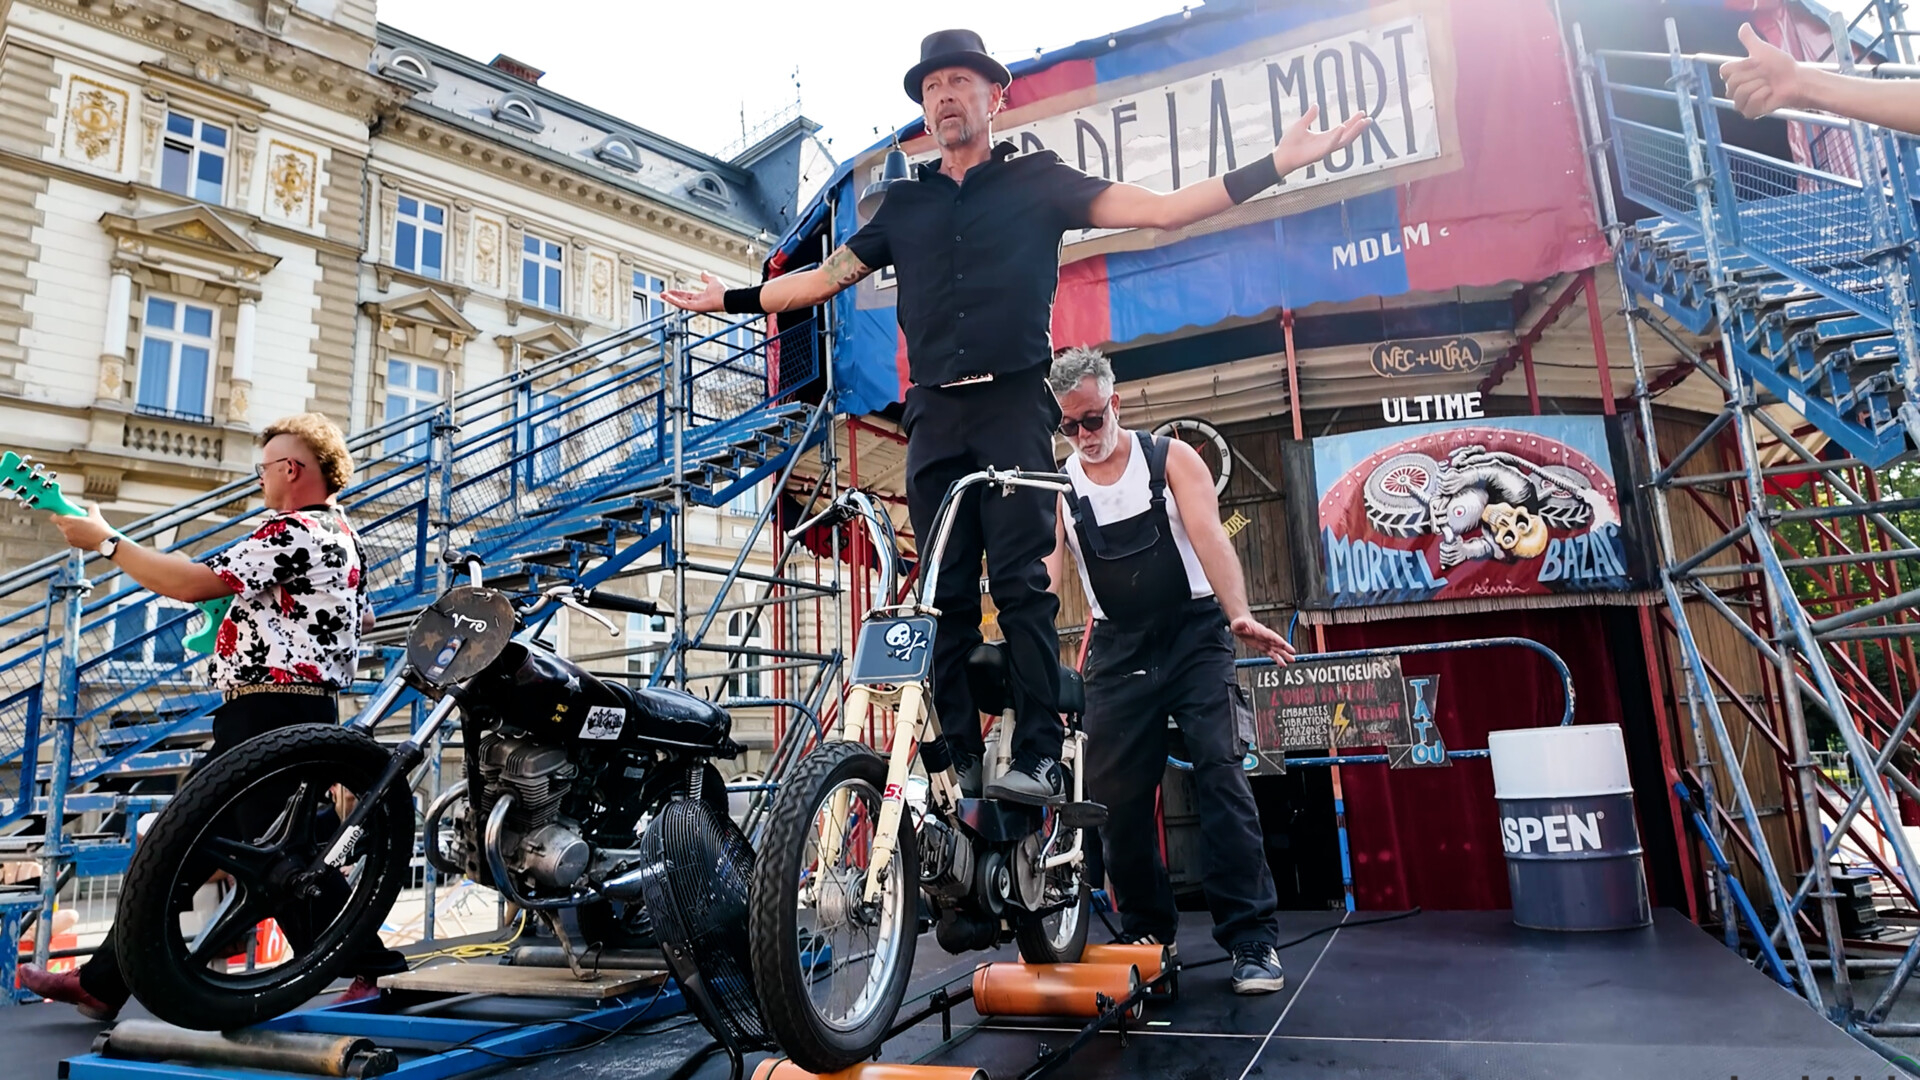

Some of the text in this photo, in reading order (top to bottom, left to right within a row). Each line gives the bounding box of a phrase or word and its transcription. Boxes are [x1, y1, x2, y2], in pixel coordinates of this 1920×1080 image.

[1267, 24, 1418, 186] MORT
[1381, 391, 1485, 423] ULTIME
[1327, 532, 1449, 594] MORTEL
[1257, 662, 1391, 687] LES AS VOLTIGEURS
[1282, 705, 1328, 717] EMBARDEES
[1282, 715, 1332, 727] VIBRATIONS
[1284, 725, 1328, 736] AMAZONES
[1284, 734, 1322, 746] COURSES
